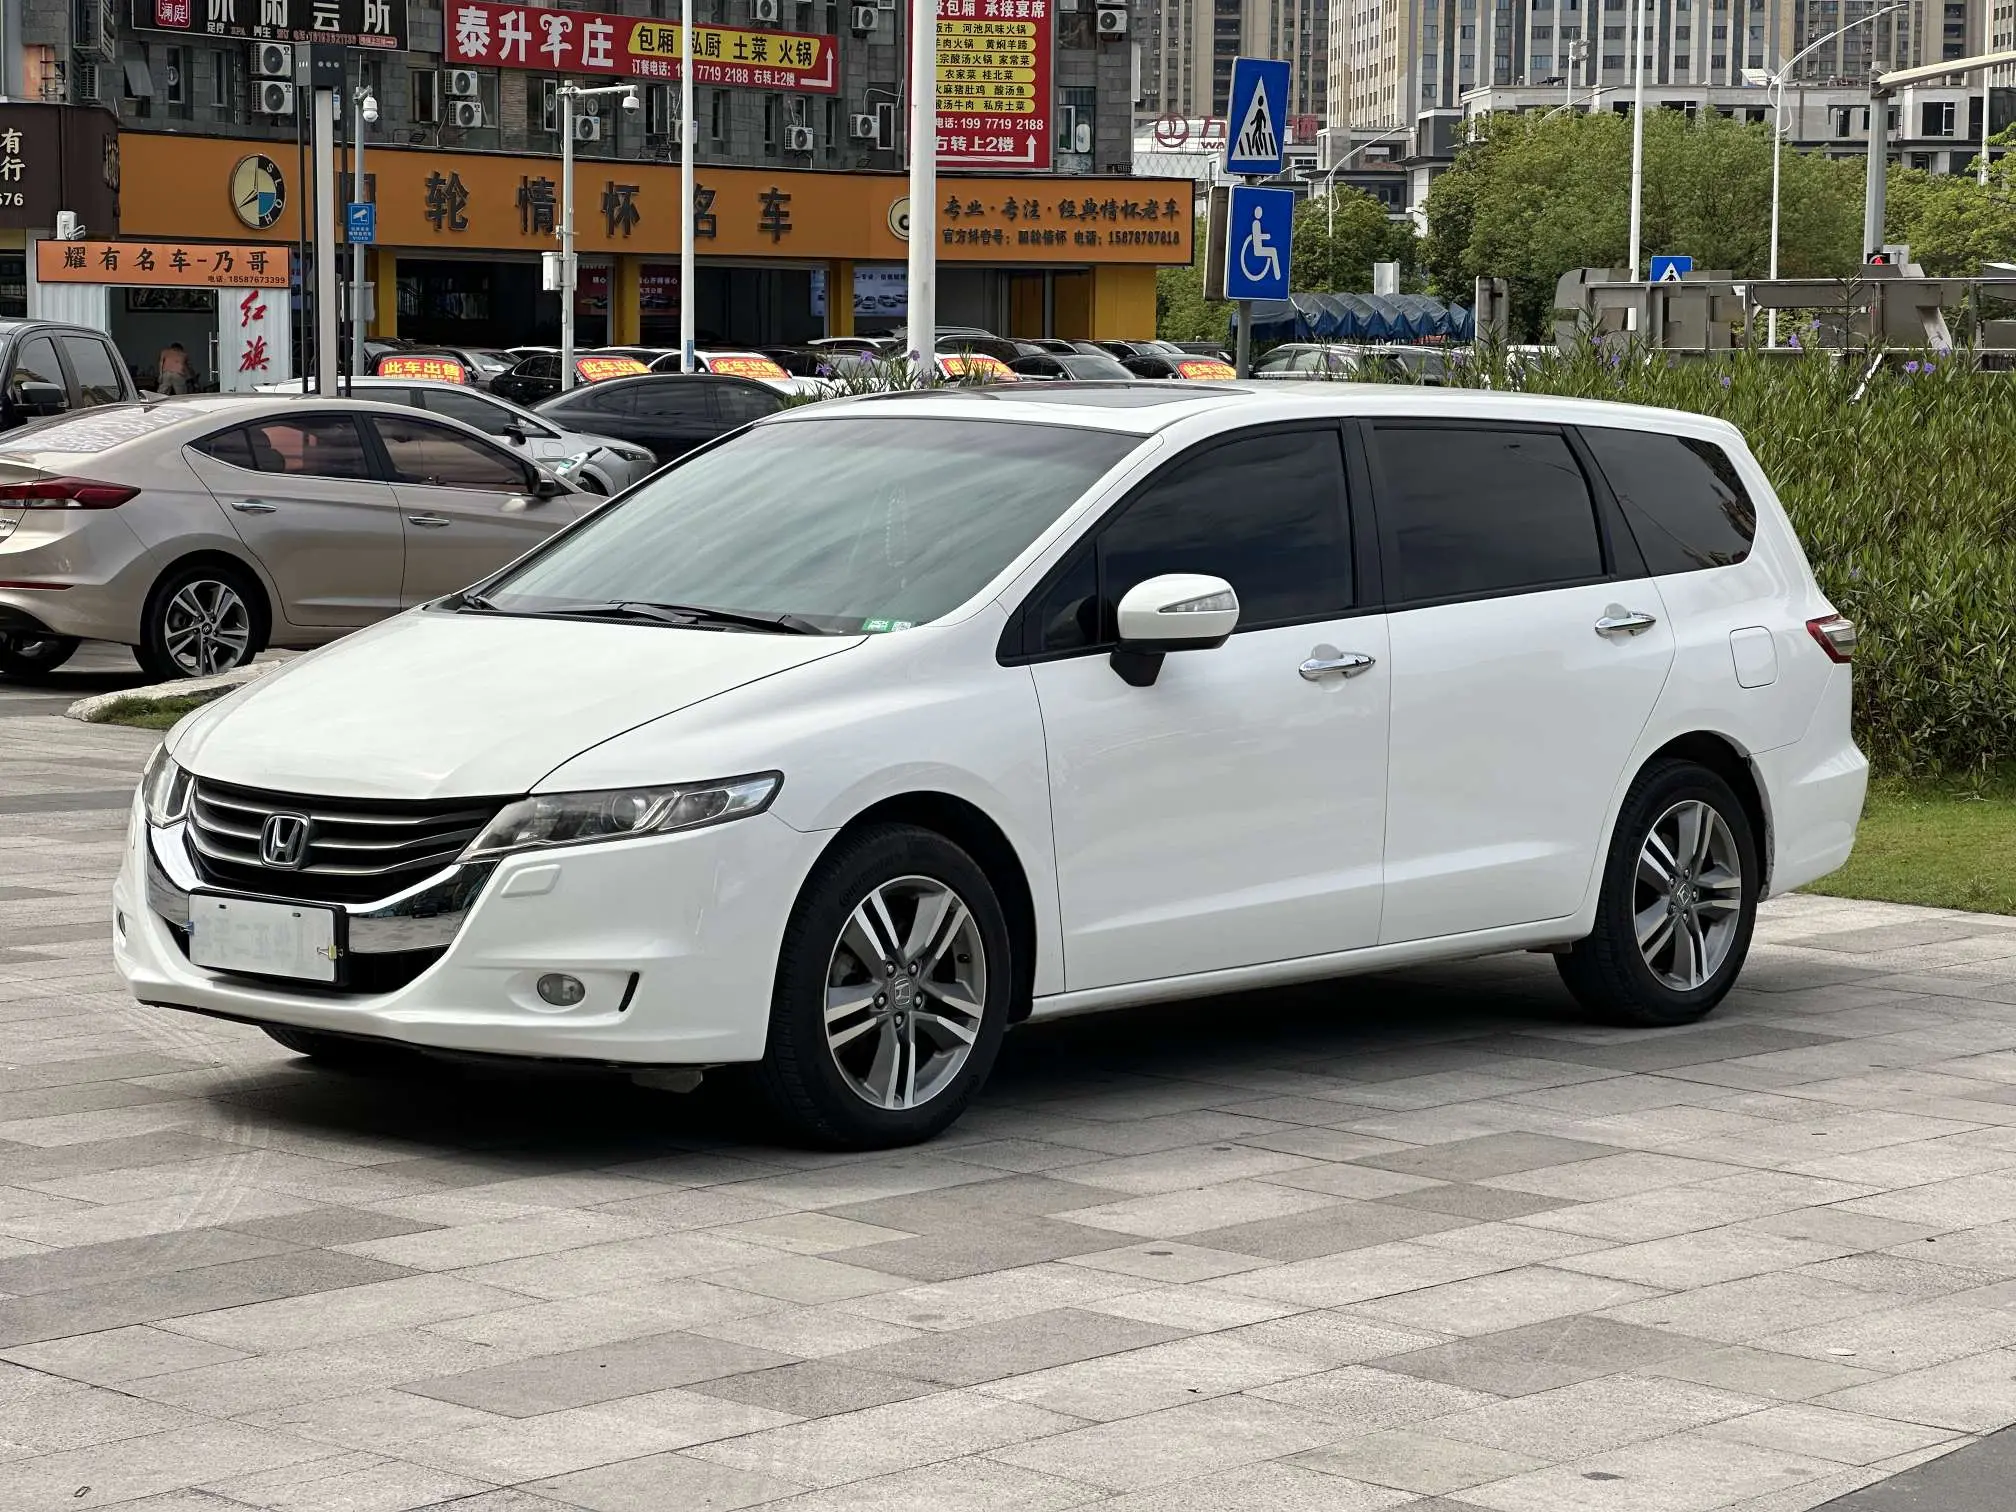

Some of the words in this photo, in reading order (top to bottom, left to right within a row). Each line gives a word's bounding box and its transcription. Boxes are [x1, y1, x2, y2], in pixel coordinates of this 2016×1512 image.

[985, 0, 1046, 18] 承接宴席
[962, 23, 1027, 35] 河池风味火锅
[637, 25, 675, 54] 包厢
[733, 35, 768, 62] 土菜
[778, 39, 812, 66] 火锅
[936, 53, 993, 65] 宗酸汤火锅
[999, 54, 1030, 66] 家常菜
[698, 64, 721, 82] 7719
[725, 66, 749, 84] 2188
[945, 69, 976, 80] 农家菜
[982, 70, 1014, 80] 桂北菜
[994, 84, 1025, 96] 酸汤鱼
[983, 100, 1025, 111] 私房土菜
[960, 118, 981, 129] 199
[985, 118, 1012, 130] 7719
[1016, 119, 1044, 131] 2188
[229, 275, 286, 284] 18587673399
[239, 289, 270, 372] 红旗
[384, 361, 460, 377] 此车出售
